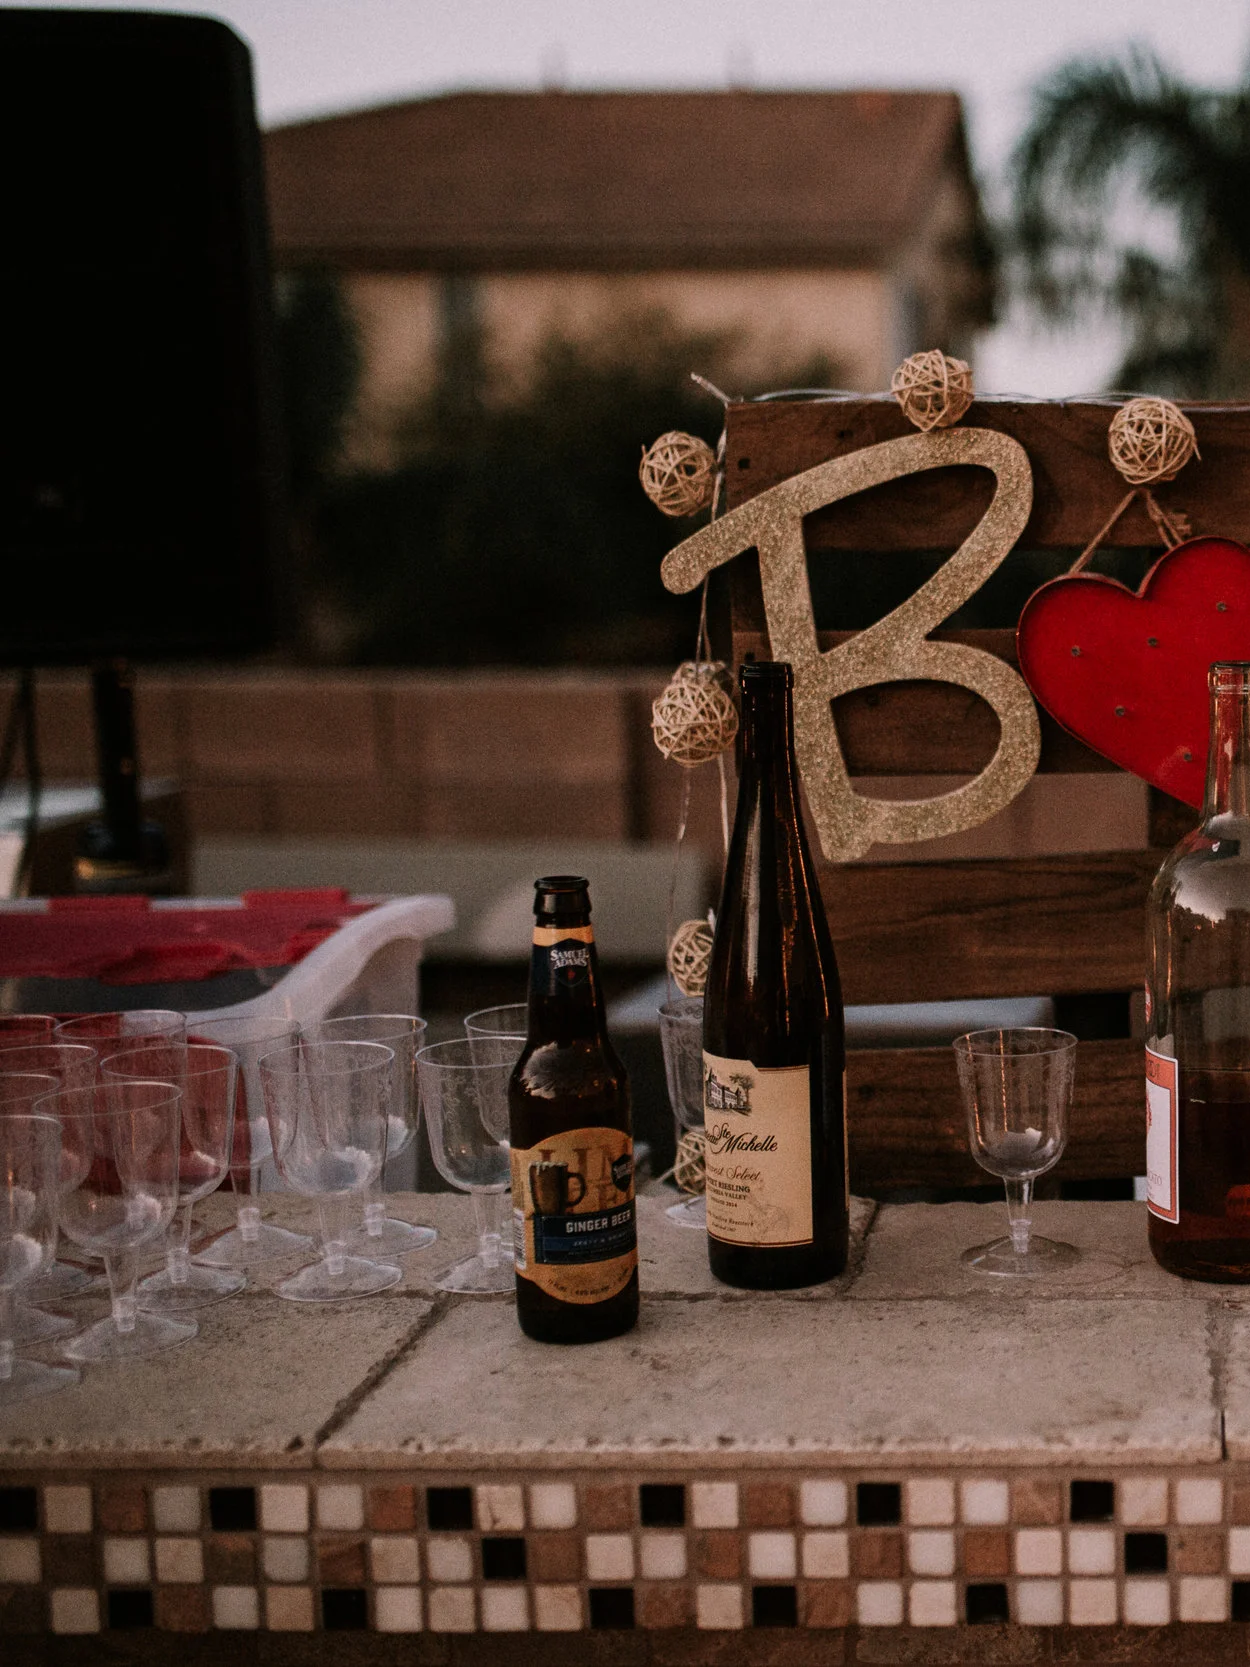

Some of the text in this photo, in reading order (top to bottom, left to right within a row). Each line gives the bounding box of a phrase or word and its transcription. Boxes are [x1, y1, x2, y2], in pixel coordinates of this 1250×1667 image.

[660, 427, 1042, 864] B
[550, 948, 590, 961] SAMUEL
[553, 958, 588, 970] ADAMS
[710, 1132, 778, 1154] Michelle
[726, 1165, 761, 1181] Select
[718, 1181, 751, 1193] RIESLING
[565, 1209, 632, 1234] GINGER BEER
